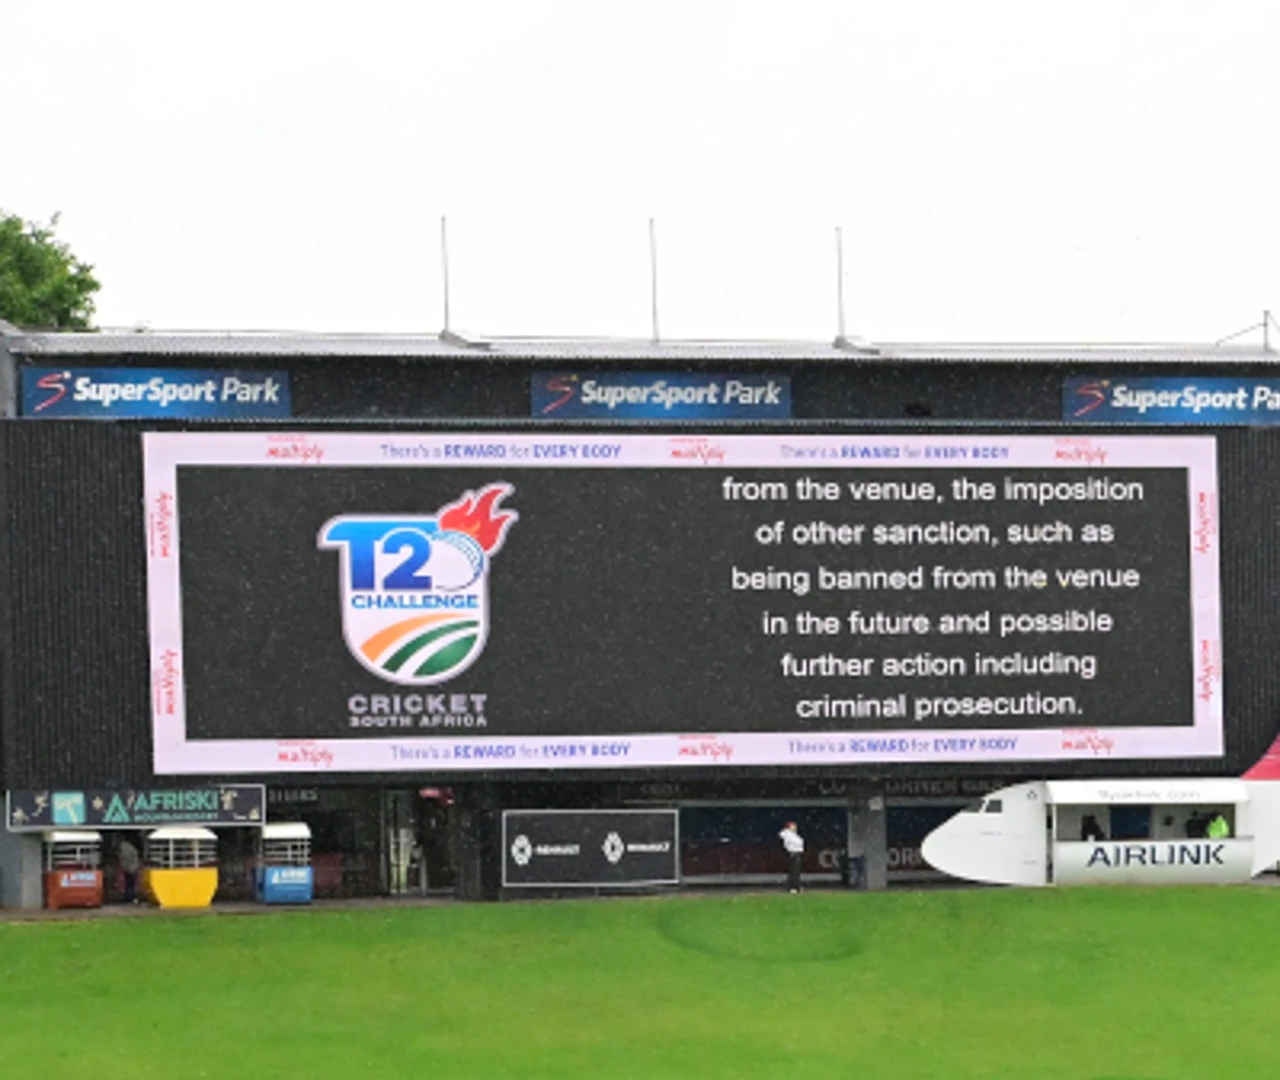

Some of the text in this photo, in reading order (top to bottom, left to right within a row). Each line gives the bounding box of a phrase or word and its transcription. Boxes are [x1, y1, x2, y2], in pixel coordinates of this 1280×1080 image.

[74, 378, 279, 407] SuperSport Park
[581, 380, 781, 410] SuperSport Park
[1111, 385, 1247, 413] SuperSport
[722, 476, 1143, 505] from the venue, the imposition
[755, 521, 1114, 547] of other sanction, such as
[731, 566, 1140, 595] being banned from the venue
[351, 594, 479, 609] CHALLENGE
[763, 610, 1113, 637] in the future and possible
[781, 652, 1097, 681] further action including
[348, 693, 488, 715] CRICKET
[796, 692, 1083, 722] criminal prosecution.
[349, 715, 488, 727] SOUTH AFRICA
[133, 789, 220, 811] AFRISKI
[1087, 844, 1225, 868] AIRLINK
